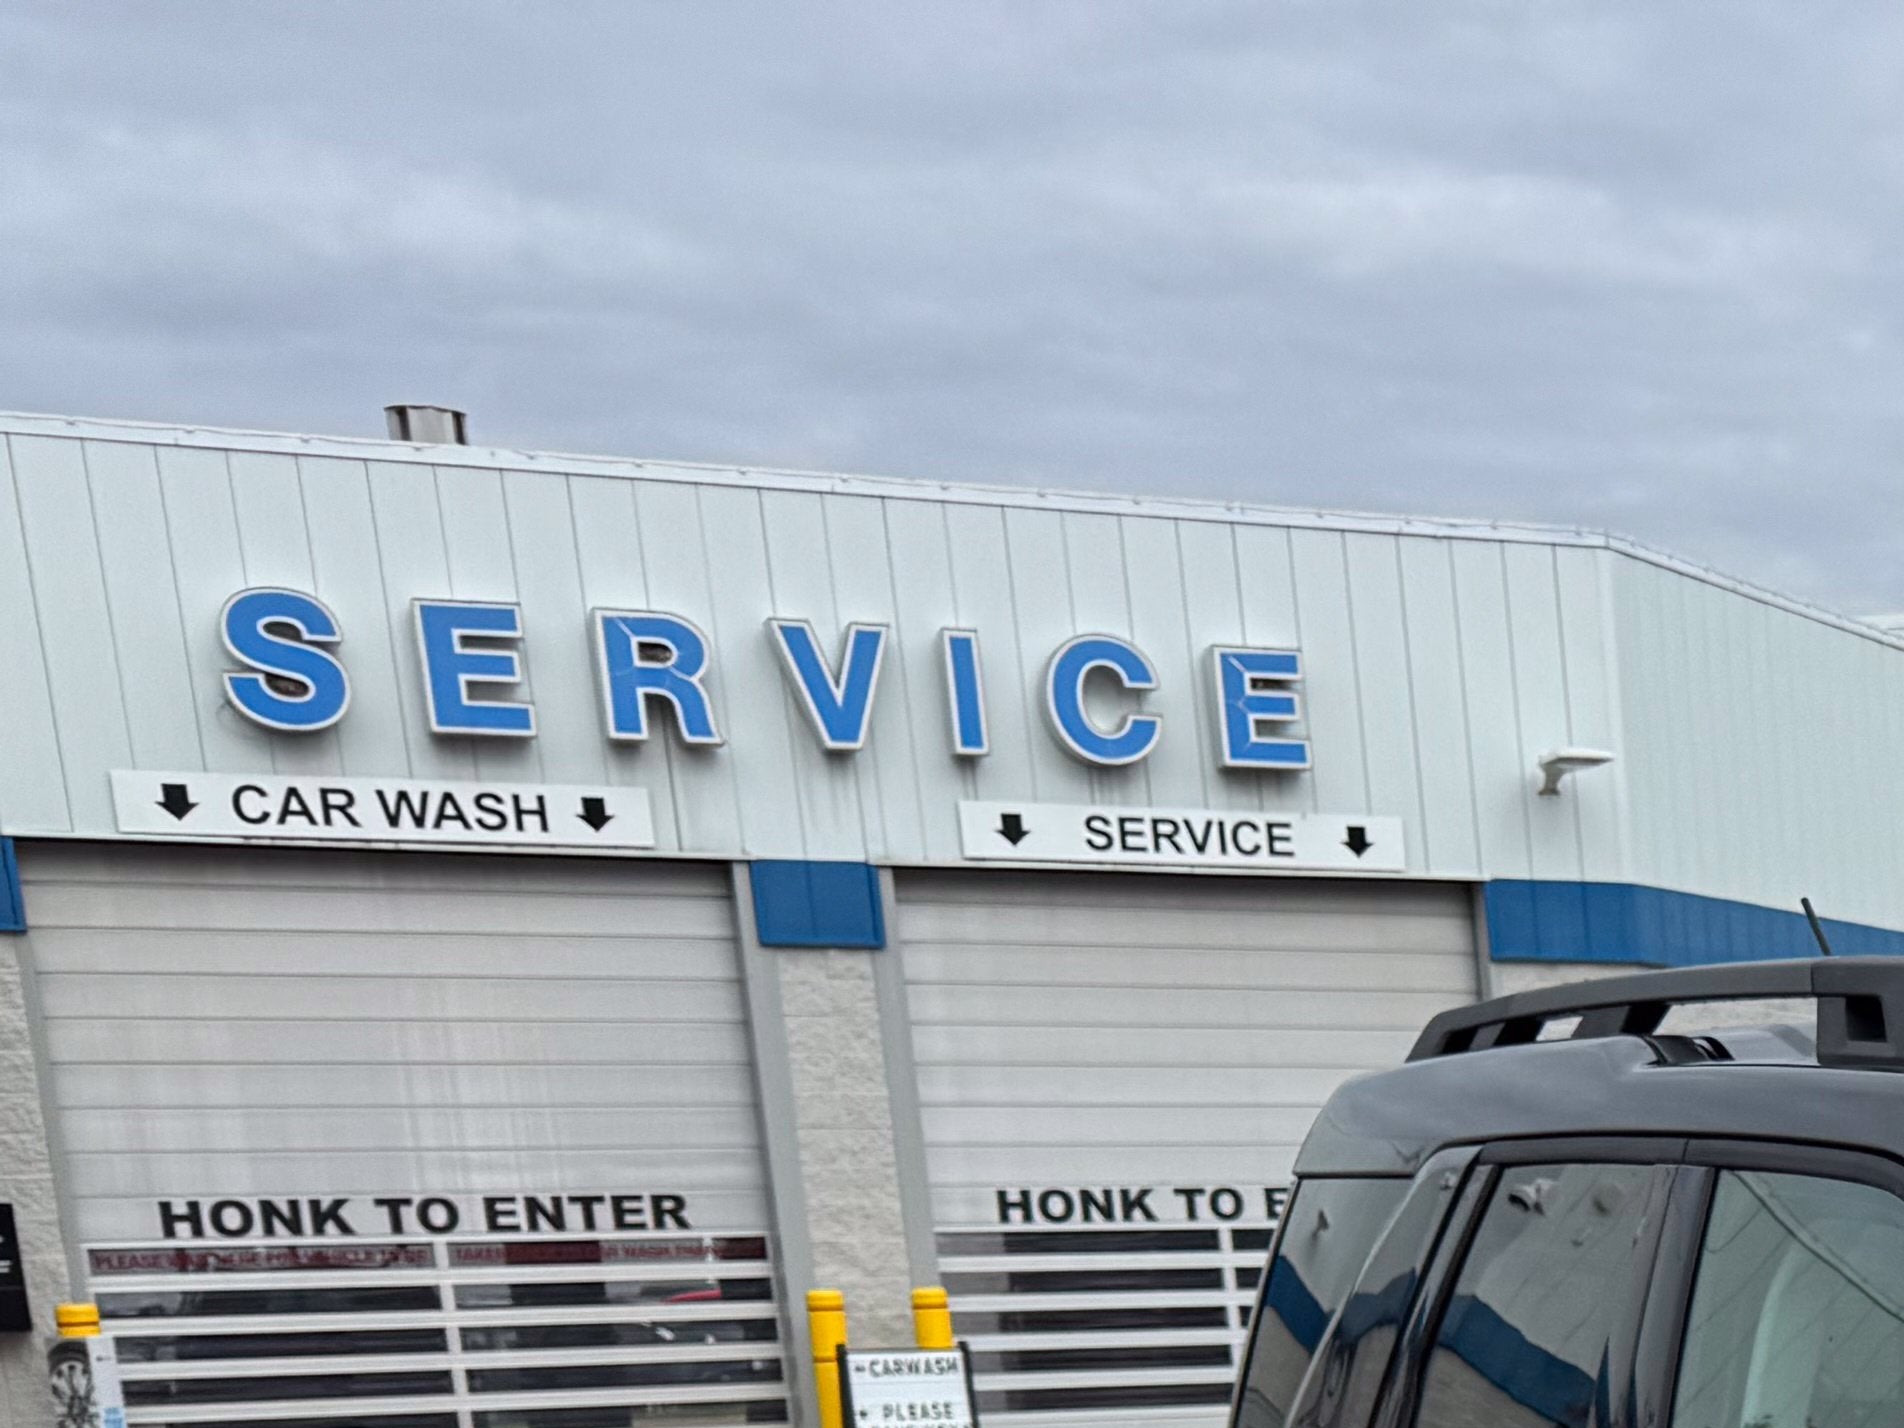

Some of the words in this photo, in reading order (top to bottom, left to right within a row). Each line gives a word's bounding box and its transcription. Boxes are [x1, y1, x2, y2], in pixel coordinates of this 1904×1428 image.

[220, 585, 1313, 771] SERVICE
[231, 783, 362, 828] CAR
[375, 788, 550, 834] WASH
[1084, 814, 1296, 858] SERVICE
[158, 1198, 356, 1239] HONK
[374, 1197, 459, 1236] TO
[483, 1194, 693, 1232] ENTER
[996, 1187, 1159, 1224] HONK
[1173, 1186, 1245, 1221] TO
[869, 1357, 959, 1377] CARWASH
[882, 1402, 954, 1421] PLEASE
